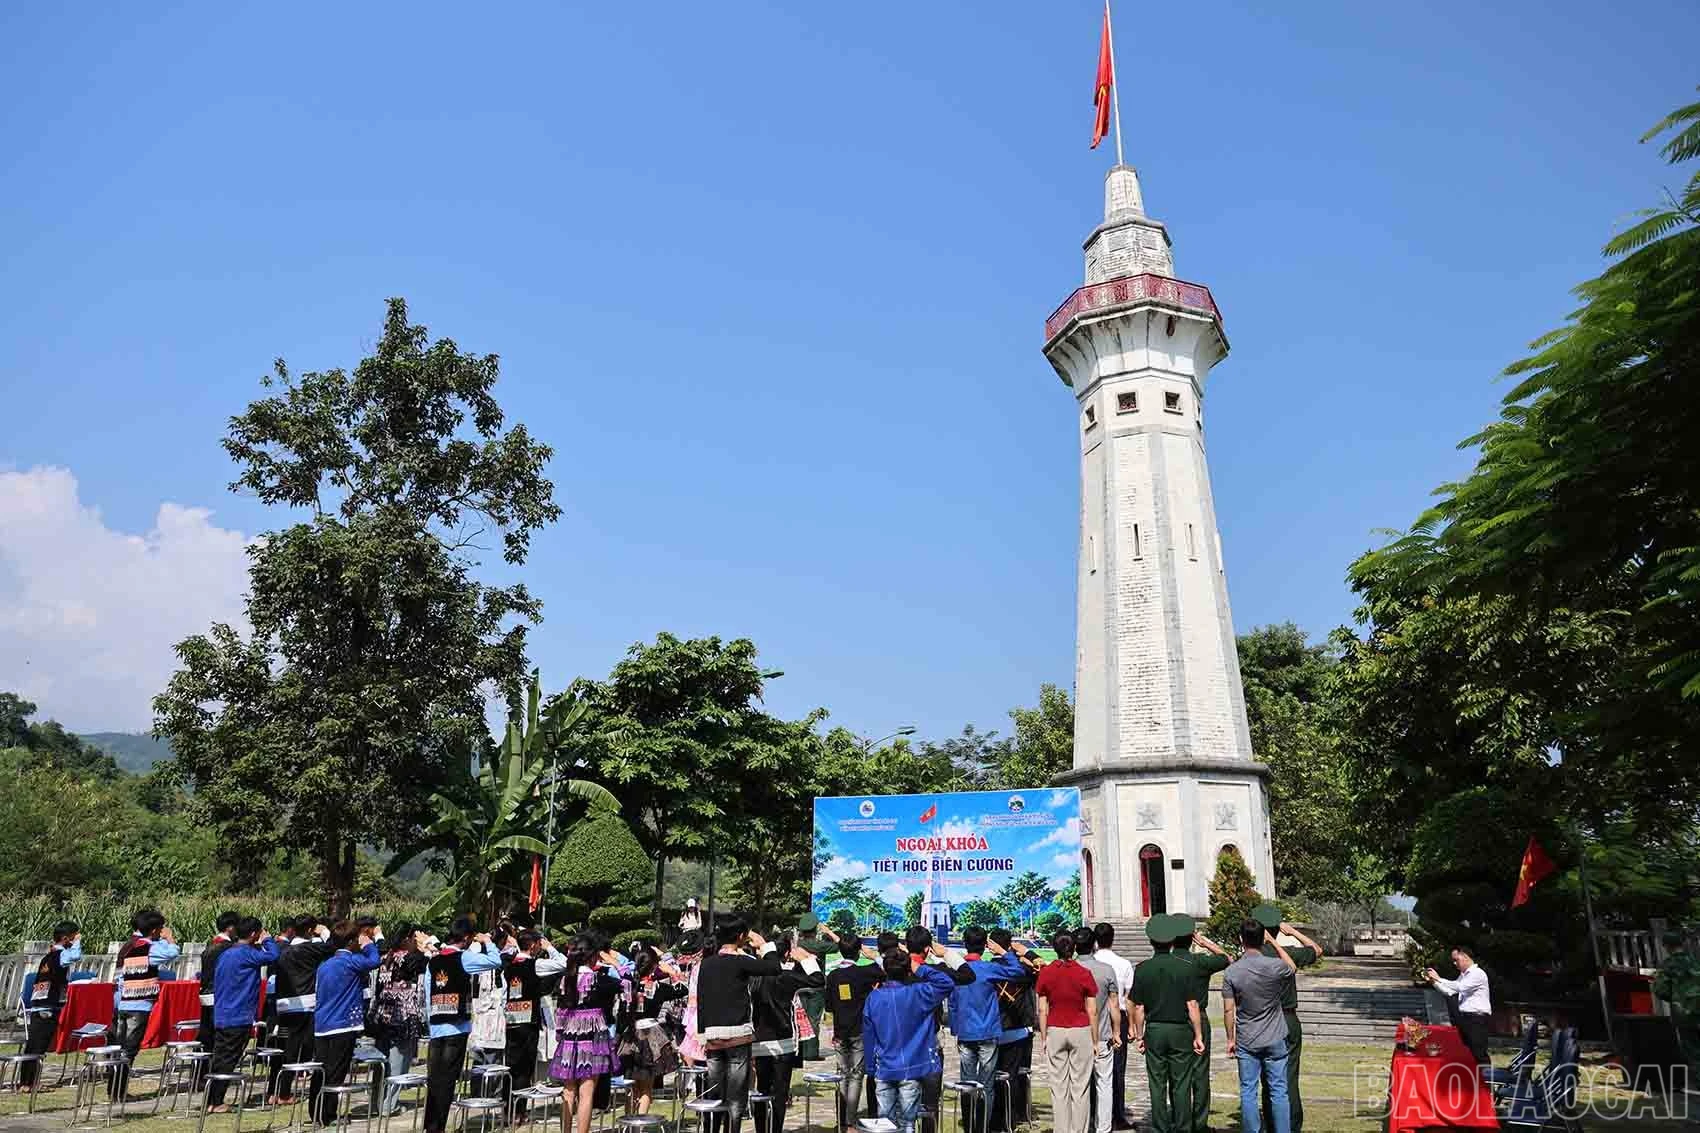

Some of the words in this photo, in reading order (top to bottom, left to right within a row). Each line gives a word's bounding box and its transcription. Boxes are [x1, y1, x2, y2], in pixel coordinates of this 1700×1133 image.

[946, 833, 988, 850] KHÓA
[873, 856, 898, 872] TIẾT
[903, 860, 928, 875] HỌC
[932, 857, 962, 871] BIÊN
[967, 858, 1013, 871] CƯƠNG
